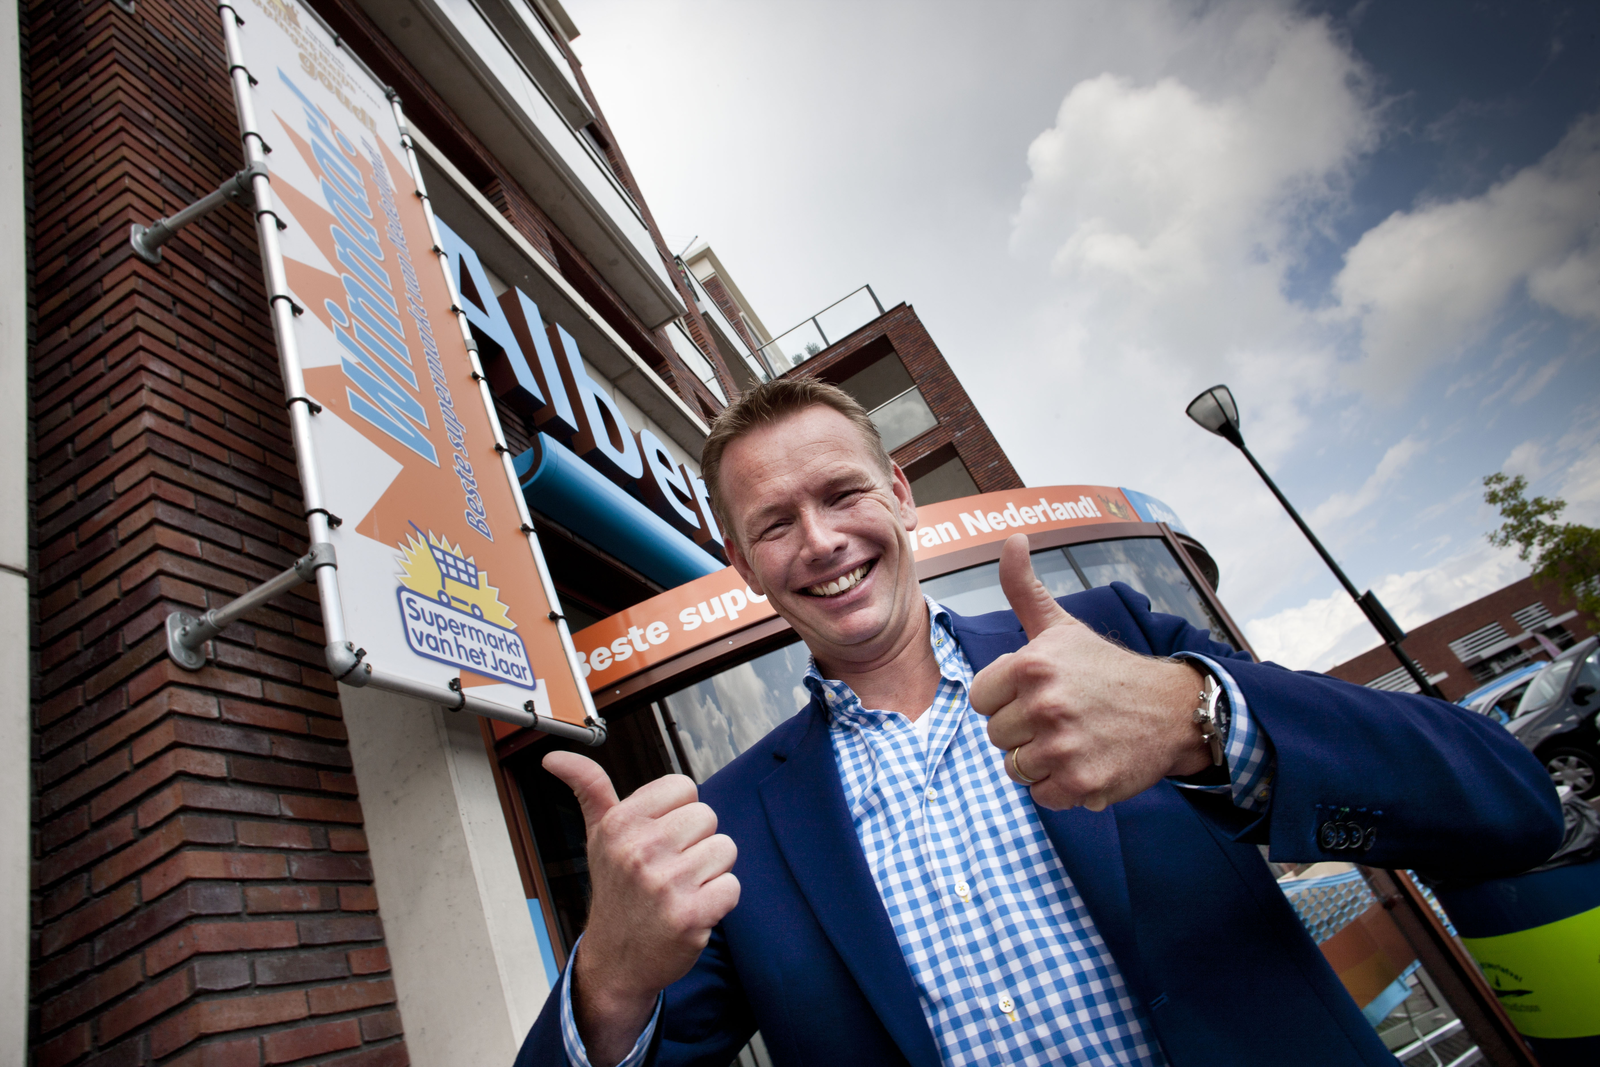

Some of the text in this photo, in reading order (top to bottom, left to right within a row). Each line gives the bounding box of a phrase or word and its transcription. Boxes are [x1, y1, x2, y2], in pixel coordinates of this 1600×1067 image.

[298, 52, 377, 138] goud!
[276, 65, 441, 468] Winnaar!
[397, 252, 424, 303] van
[405, 292, 470, 458] supermarkt
[453, 452, 494, 543] Beste
[959, 495, 1102, 538] Nederland!
[405, 597, 522, 659] Supermarkt
[411, 627, 528, 681] van het Jaar
